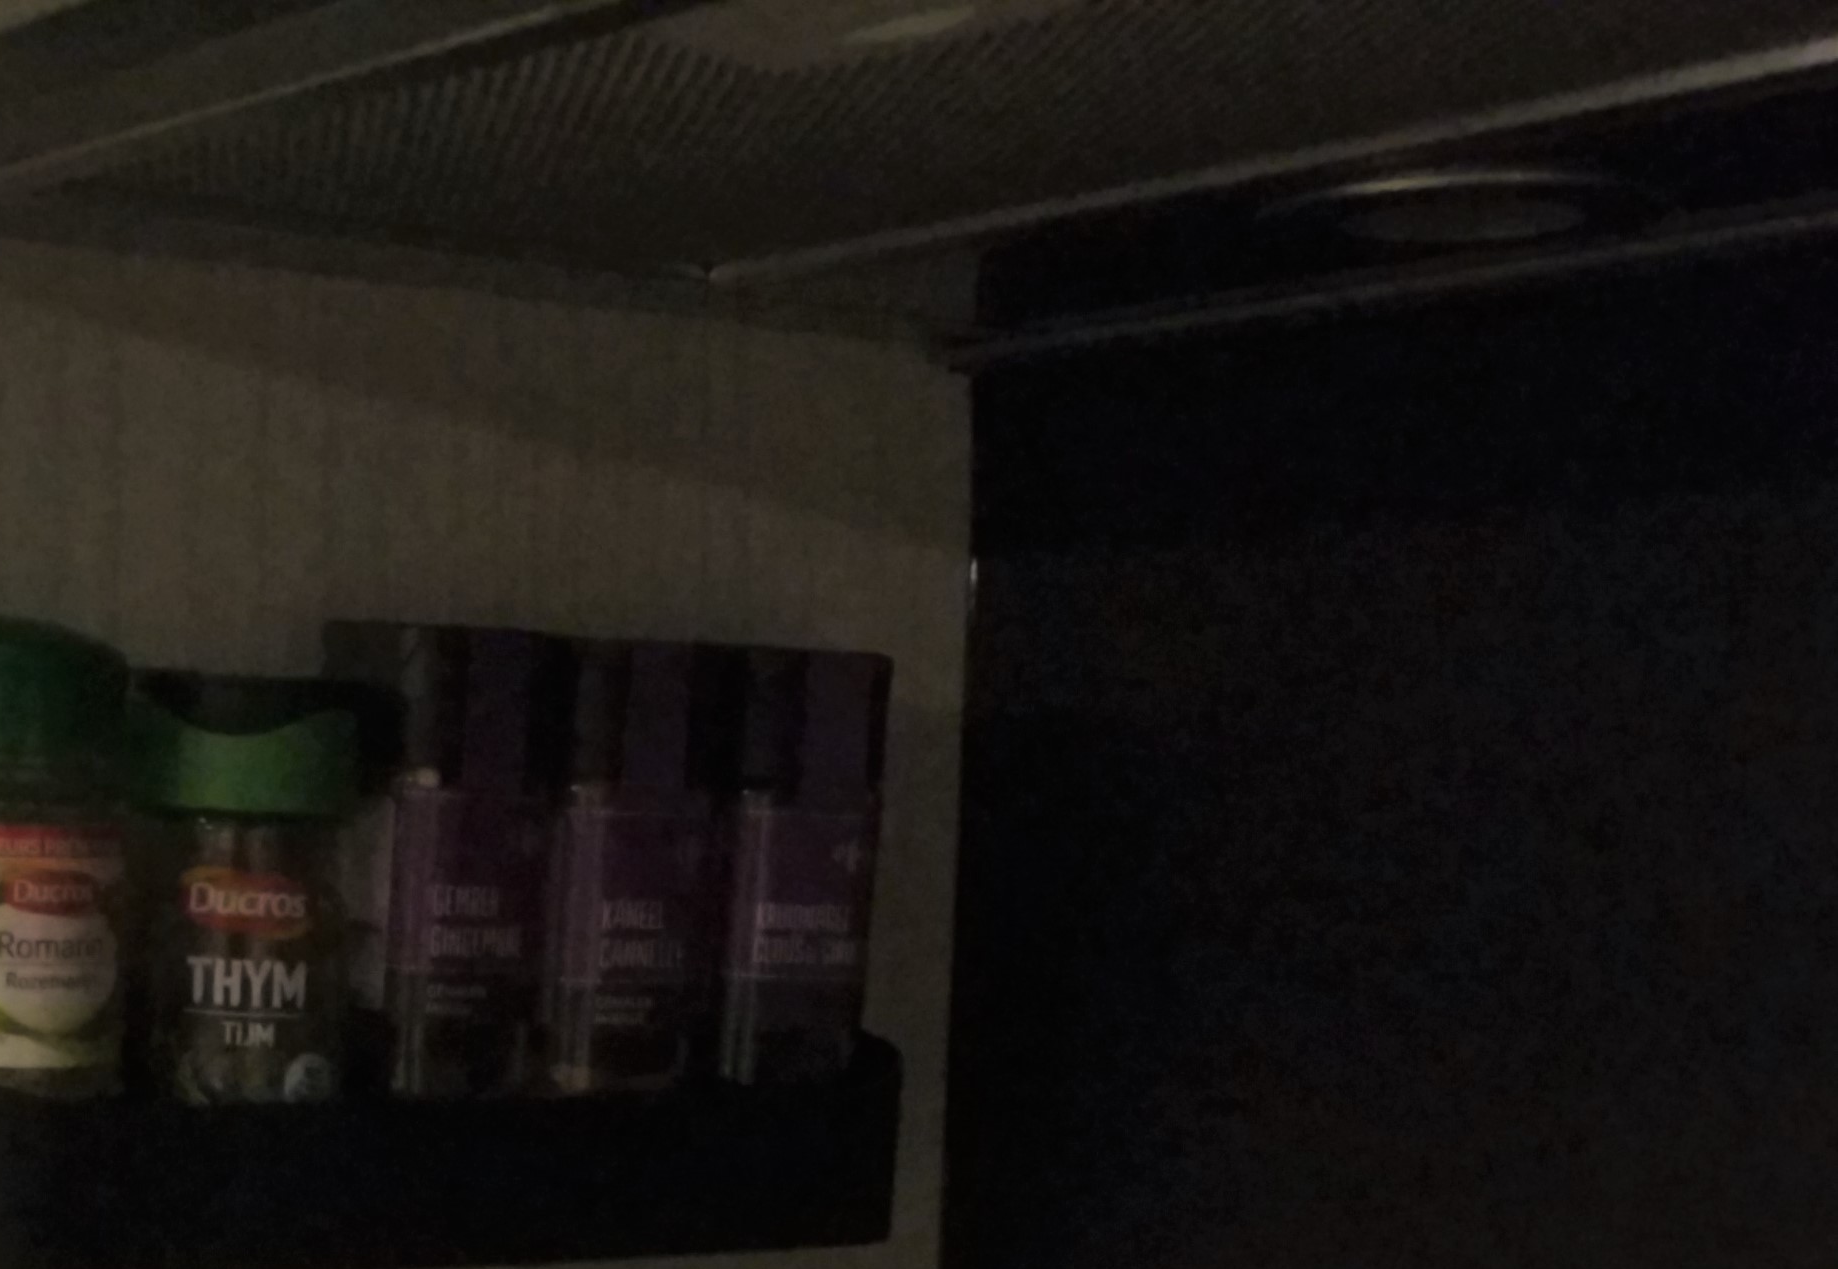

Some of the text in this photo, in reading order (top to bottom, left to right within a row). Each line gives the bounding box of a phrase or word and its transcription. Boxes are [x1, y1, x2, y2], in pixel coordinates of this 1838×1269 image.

[189, 881, 307, 919] Ducros
[186, 954, 308, 1009] THYM
[221, 1021, 276, 1048] TIJM
